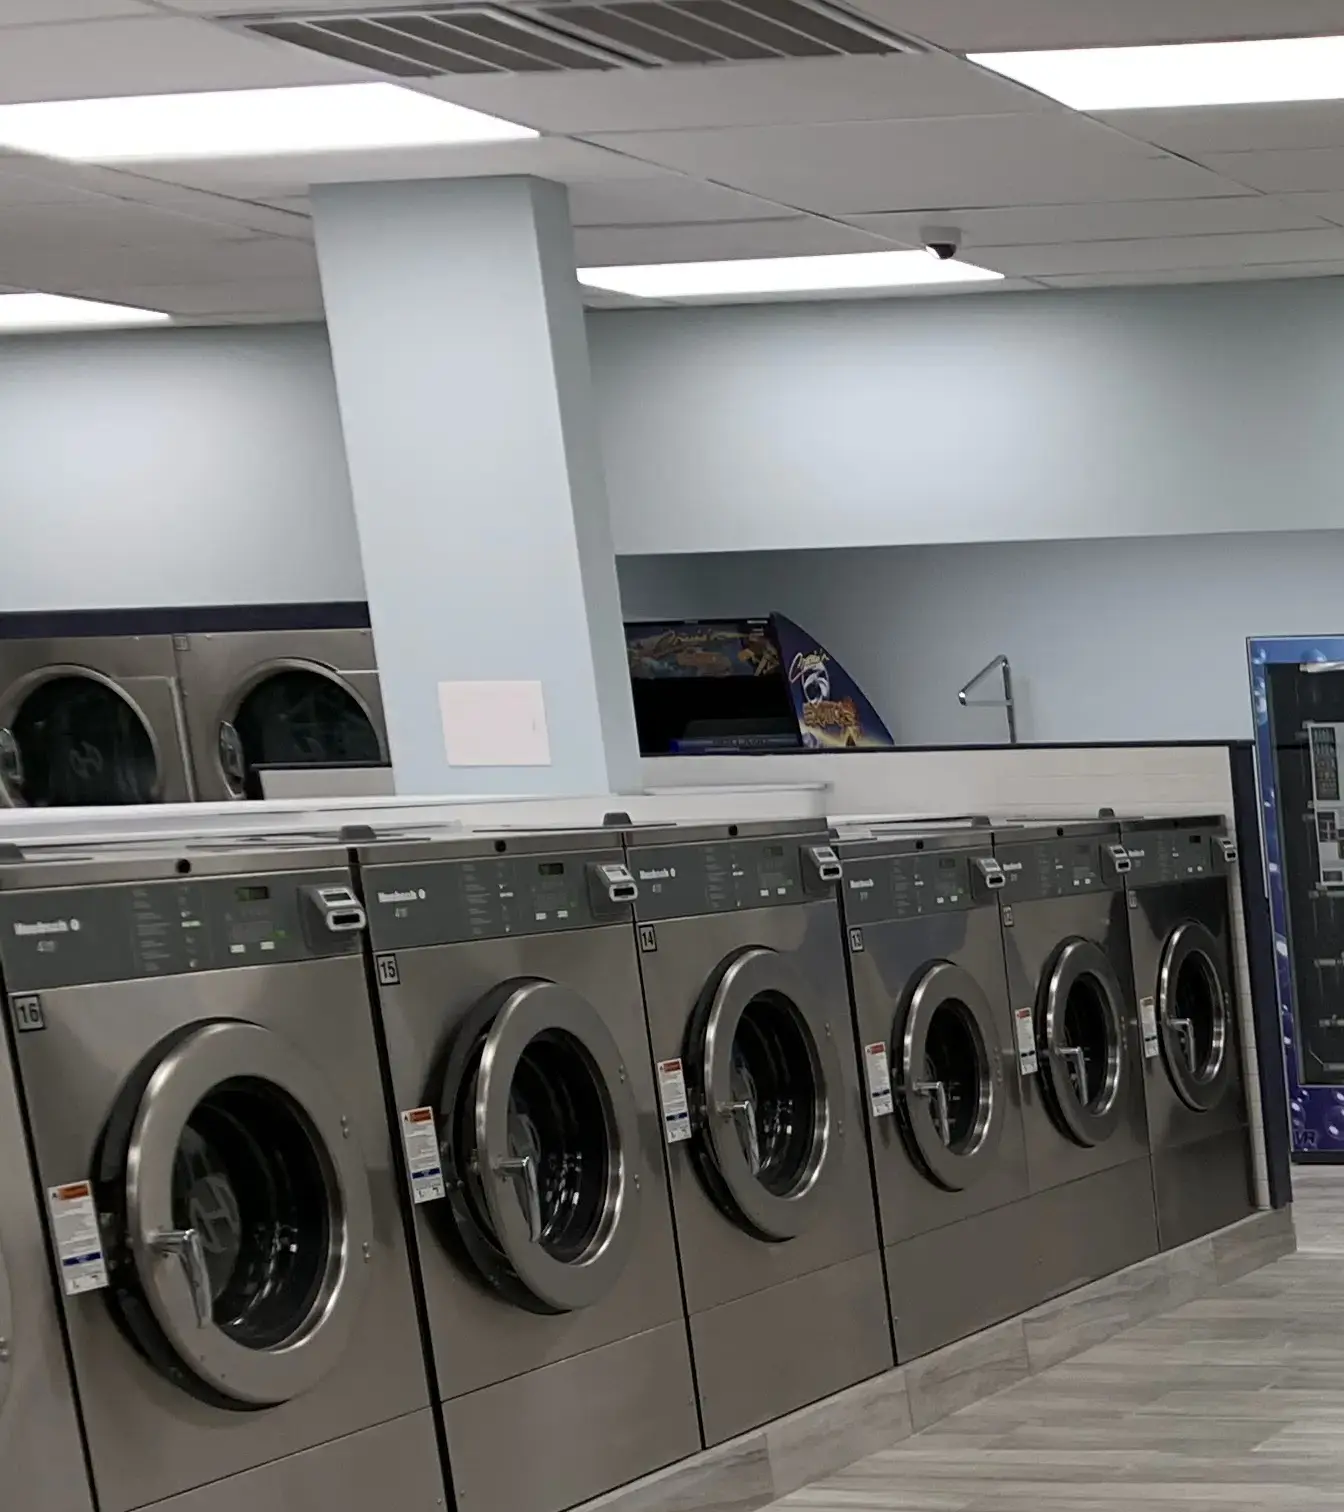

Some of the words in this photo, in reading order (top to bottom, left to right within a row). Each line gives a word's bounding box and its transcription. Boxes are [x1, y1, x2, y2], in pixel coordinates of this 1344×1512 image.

[642, 931, 655, 947] 14
[380, 960, 396, 979] 15
[17, 1002, 40, 1023] 16
